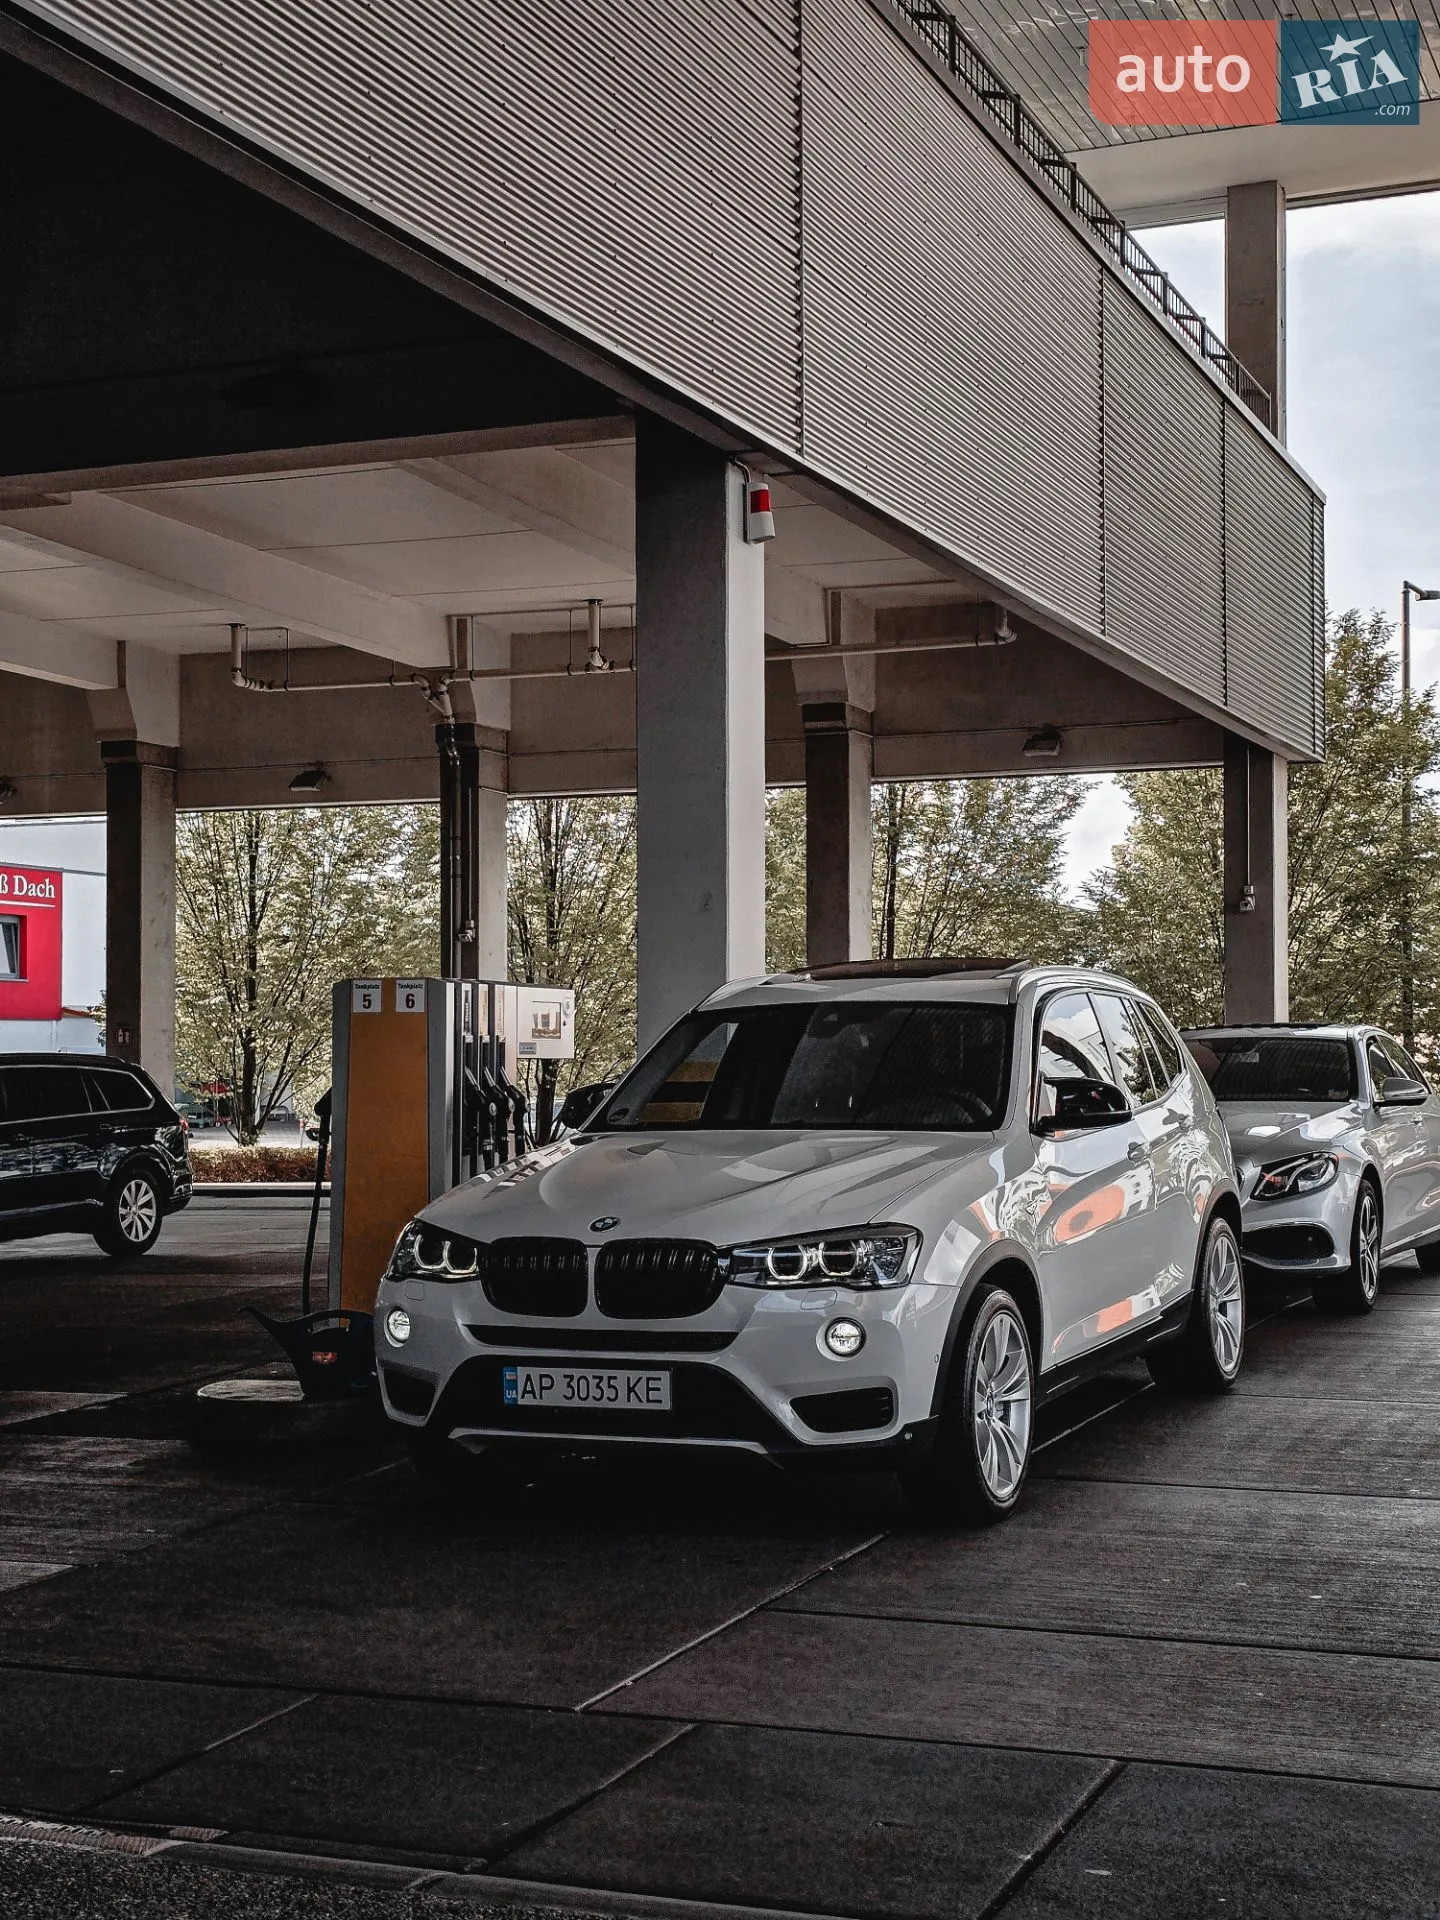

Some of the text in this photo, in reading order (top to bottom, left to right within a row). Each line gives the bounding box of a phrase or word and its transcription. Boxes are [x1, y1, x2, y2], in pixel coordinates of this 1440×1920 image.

[13, 875, 56, 899] Dach
[362, 994, 372, 1009] 5
[405, 993, 416, 1009] 6
[506, 1389, 518, 1399] UA
[521, 1373, 663, 1404] AP 3035 KE
